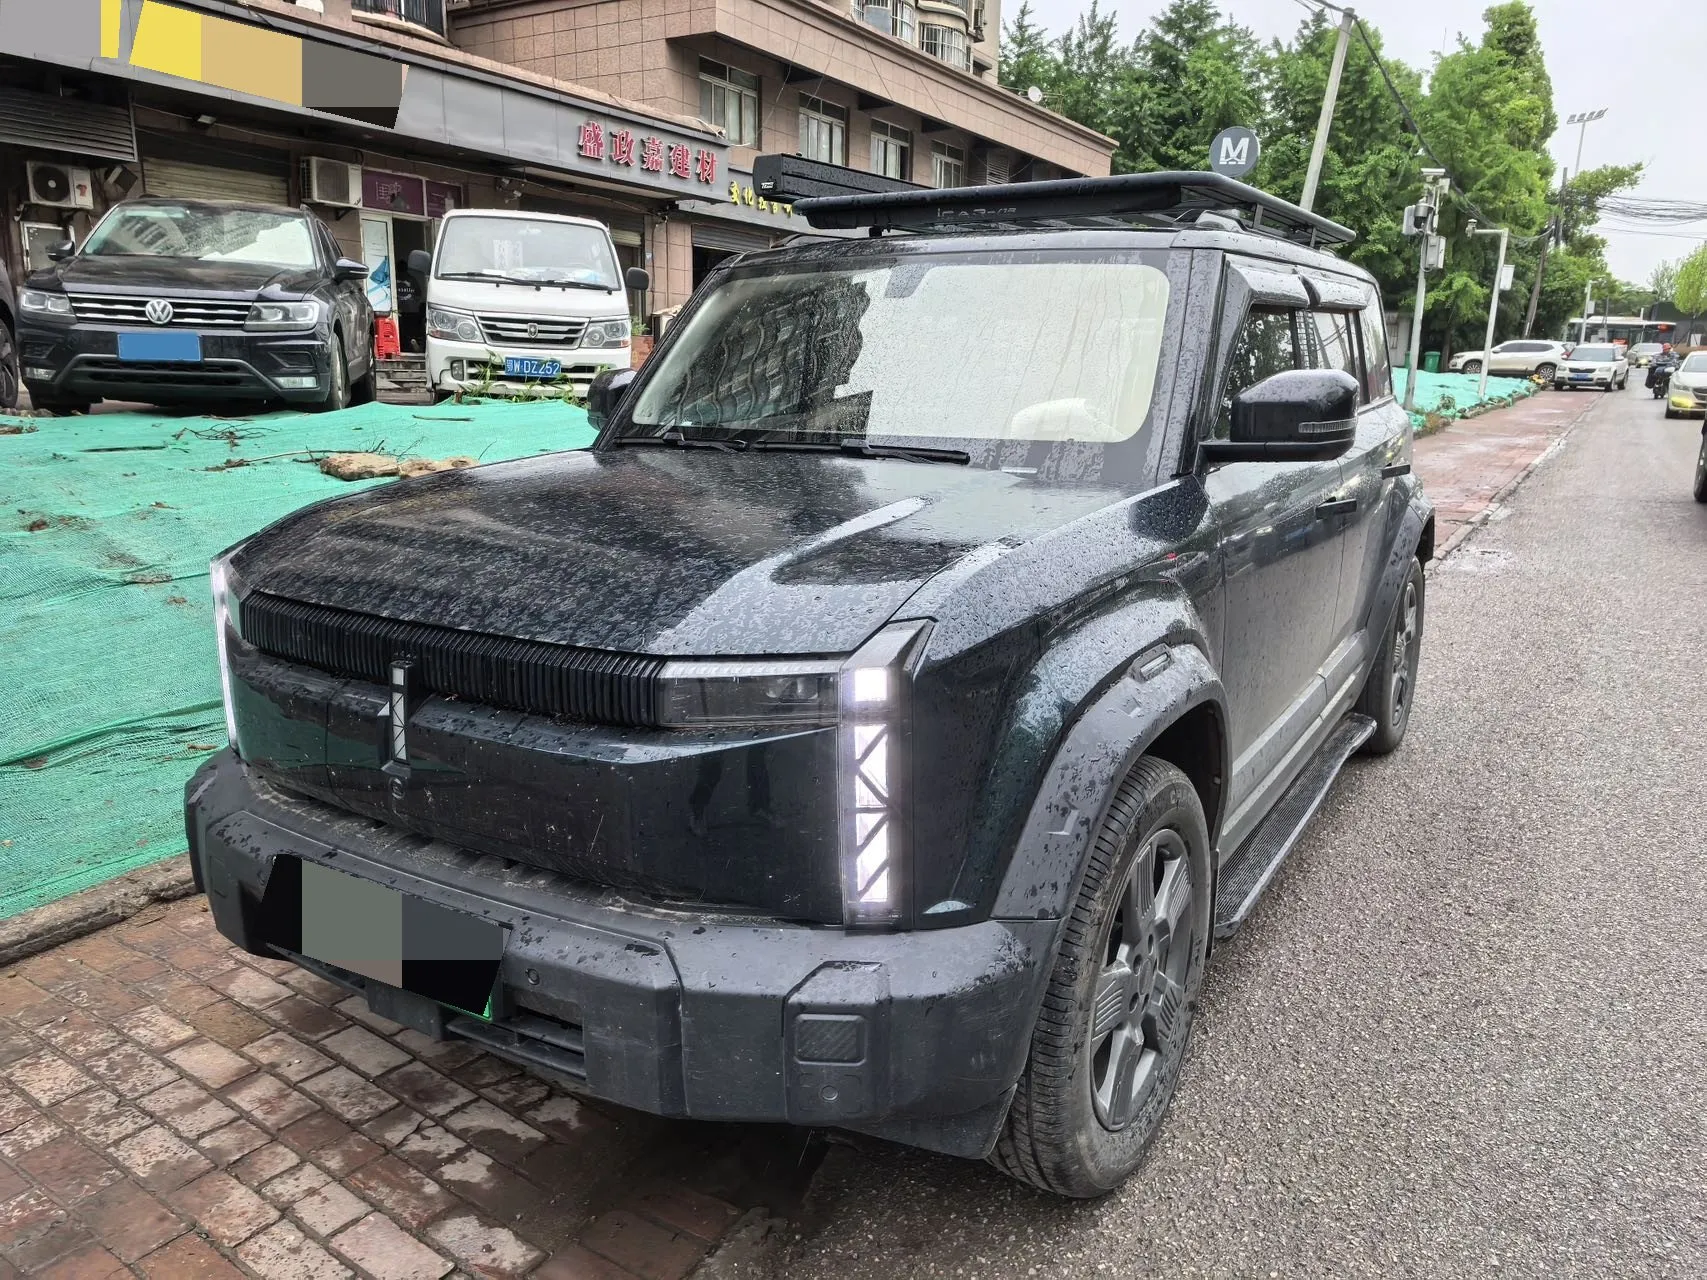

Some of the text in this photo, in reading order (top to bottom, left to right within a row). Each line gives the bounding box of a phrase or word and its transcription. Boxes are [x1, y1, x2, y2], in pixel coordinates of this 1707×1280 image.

[578, 121, 718, 184] 盛政嘉建材
